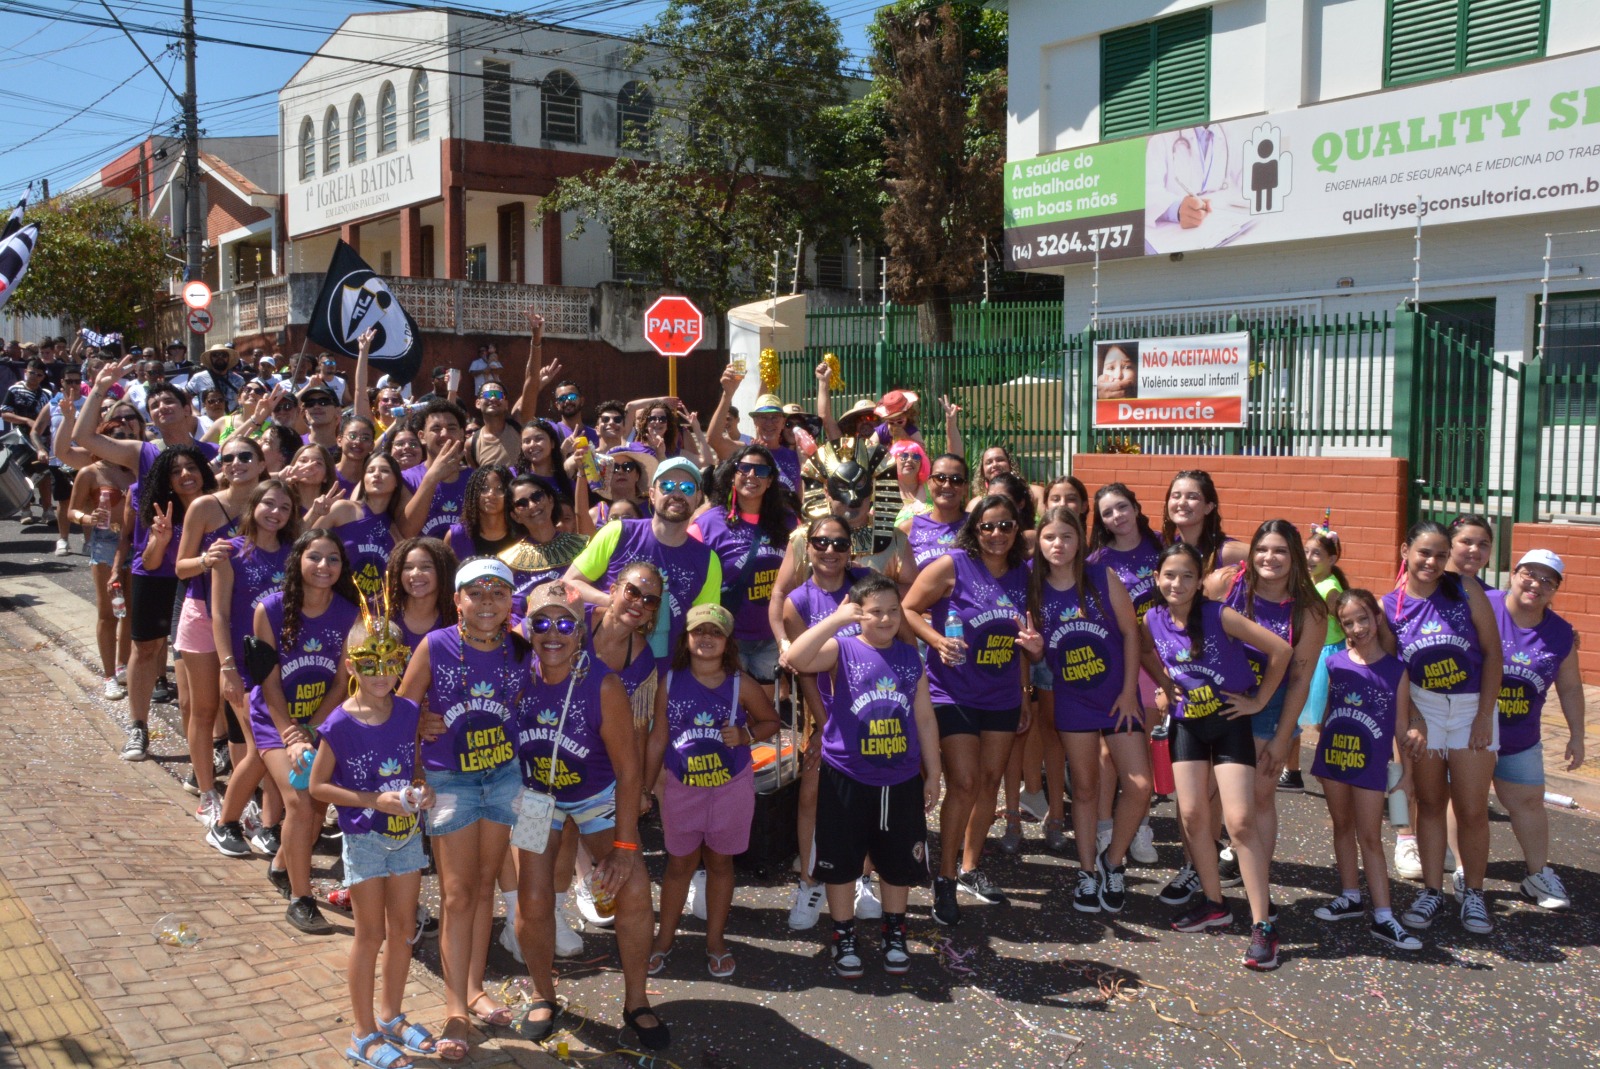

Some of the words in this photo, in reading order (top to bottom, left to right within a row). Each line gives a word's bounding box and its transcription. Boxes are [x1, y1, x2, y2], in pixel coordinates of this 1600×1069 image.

[1312, 98, 1531, 173] QUALITY
[1012, 164, 1023, 181] A
[1026, 156, 1070, 179] saúde
[1074, 152, 1094, 170] do
[1325, 175, 1388, 193] ENGENHARIA
[1390, 172, 1405, 184] DE
[1406, 163, 1473, 182] SEGURANÇA
[1475, 161, 1483, 172] E
[1485, 153, 1542, 171] MEDICINA
[1545, 150, 1565, 163] DO
[317, 173, 357, 209] IGREJA
[361, 154, 415, 195] BATISTA
[1012, 173, 1101, 200] trabalhador
[326, 208, 334, 219] EM
[360, 192, 390, 208] PAULISTA
[1012, 207, 1034, 220] em
[1038, 199, 1073, 217] boas
[1077, 191, 1118, 211] mãos
[1012, 243, 1032, 261] (14)
[1037, 224, 1134, 257] 3264.3737
[649, 318, 698, 335] PARE
[1142, 347, 1168, 368] NÃO
[1172, 346, 1239, 367] ACEITAMOS
[1180, 373, 1207, 388] sexual
[1209, 371, 1240, 386] infantil
[1118, 401, 1215, 421] Denuncie
[438, 515, 451, 525] DAS
[969, 610, 994, 628] BLOCO
[993, 609, 1008, 619] DAS
[1059, 622, 1075, 635] DAS
[1075, 621, 1109, 639] ESTRELAS
[986, 634, 1015, 648] AGITA
[1415, 636, 1435, 650] DAS
[298, 655, 315, 668] DAS
[1065, 645, 1096, 665] AGITA
[1062, 658, 1106, 681] LENÇÓIS
[1424, 658, 1459, 678] AGITA
[1503, 664, 1521, 676] DAS
[296, 681, 326, 700] AGITA
[870, 688, 887, 701] DAS
[443, 703, 466, 728] LOCO
[1337, 707, 1352, 718] DAS
[1352, 709, 1383, 739] ESTRELAS
[869, 718, 903, 736] AGITA
[529, 728, 548, 741] DAS
[549, 729, 590, 759] ESTRELAS
[861, 734, 907, 759] LENÇÓIS
[1332, 733, 1360, 751] AGITA
[688, 752, 722, 772] AGITA
[1325, 748, 1366, 771] LENÇÓIS
